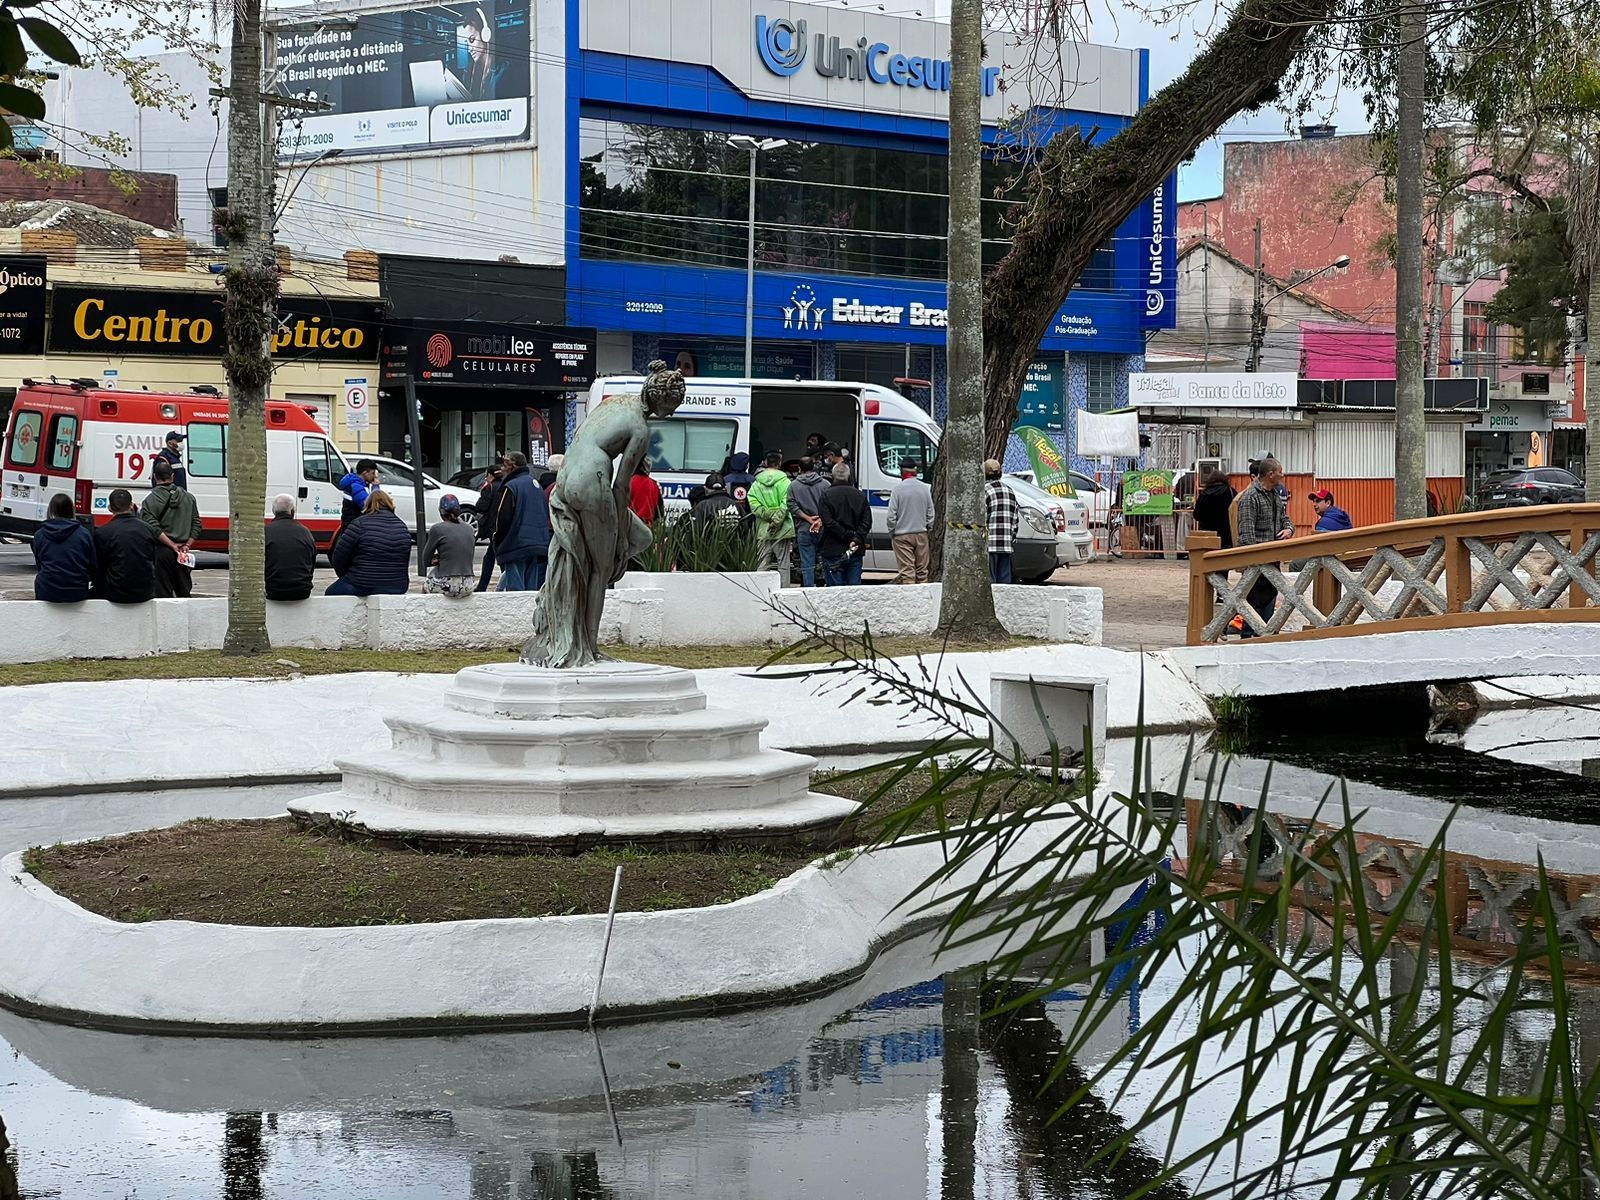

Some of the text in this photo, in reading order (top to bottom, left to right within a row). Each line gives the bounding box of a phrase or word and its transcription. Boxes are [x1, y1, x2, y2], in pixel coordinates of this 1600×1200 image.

[294, 31, 338, 47] faculdade
[341, 31, 352, 41] na
[276, 40, 404, 66] melhor educação a distância
[289, 66, 315, 82] Brasil
[316, 62, 355, 80] segundo
[356, 64, 363, 74] o
[364, 59, 389, 73] MEC.
[814, 34, 1001, 97] UniCesur
[446, 108, 512, 126] Unicesumar
[277, 132, 334, 148] 53) 3201-2009
[0, 266, 43, 288] Óptico
[625, 301, 664, 313] 32012009
[832, 297, 905, 325] Educar
[73, 298, 213, 344] Centro
[1061, 314, 1092, 325] Graduação
[269, 316, 364, 353] ptico
[1055, 325, 1098, 336] Pós-Graduação
[467, 334, 535, 356] mobi.lee
[462, 360, 536, 373] CELULARES
[713, 362, 745, 371] Bem-Esta
[774, 355, 794, 366] Saúde
[1188, 380, 1287, 399] Banca da Neto
[352, 391, 361, 405] E
[725, 397, 737, 408] RS
[1489, 415, 1519, 429] pemac
[114, 434, 163, 451] SAMU
